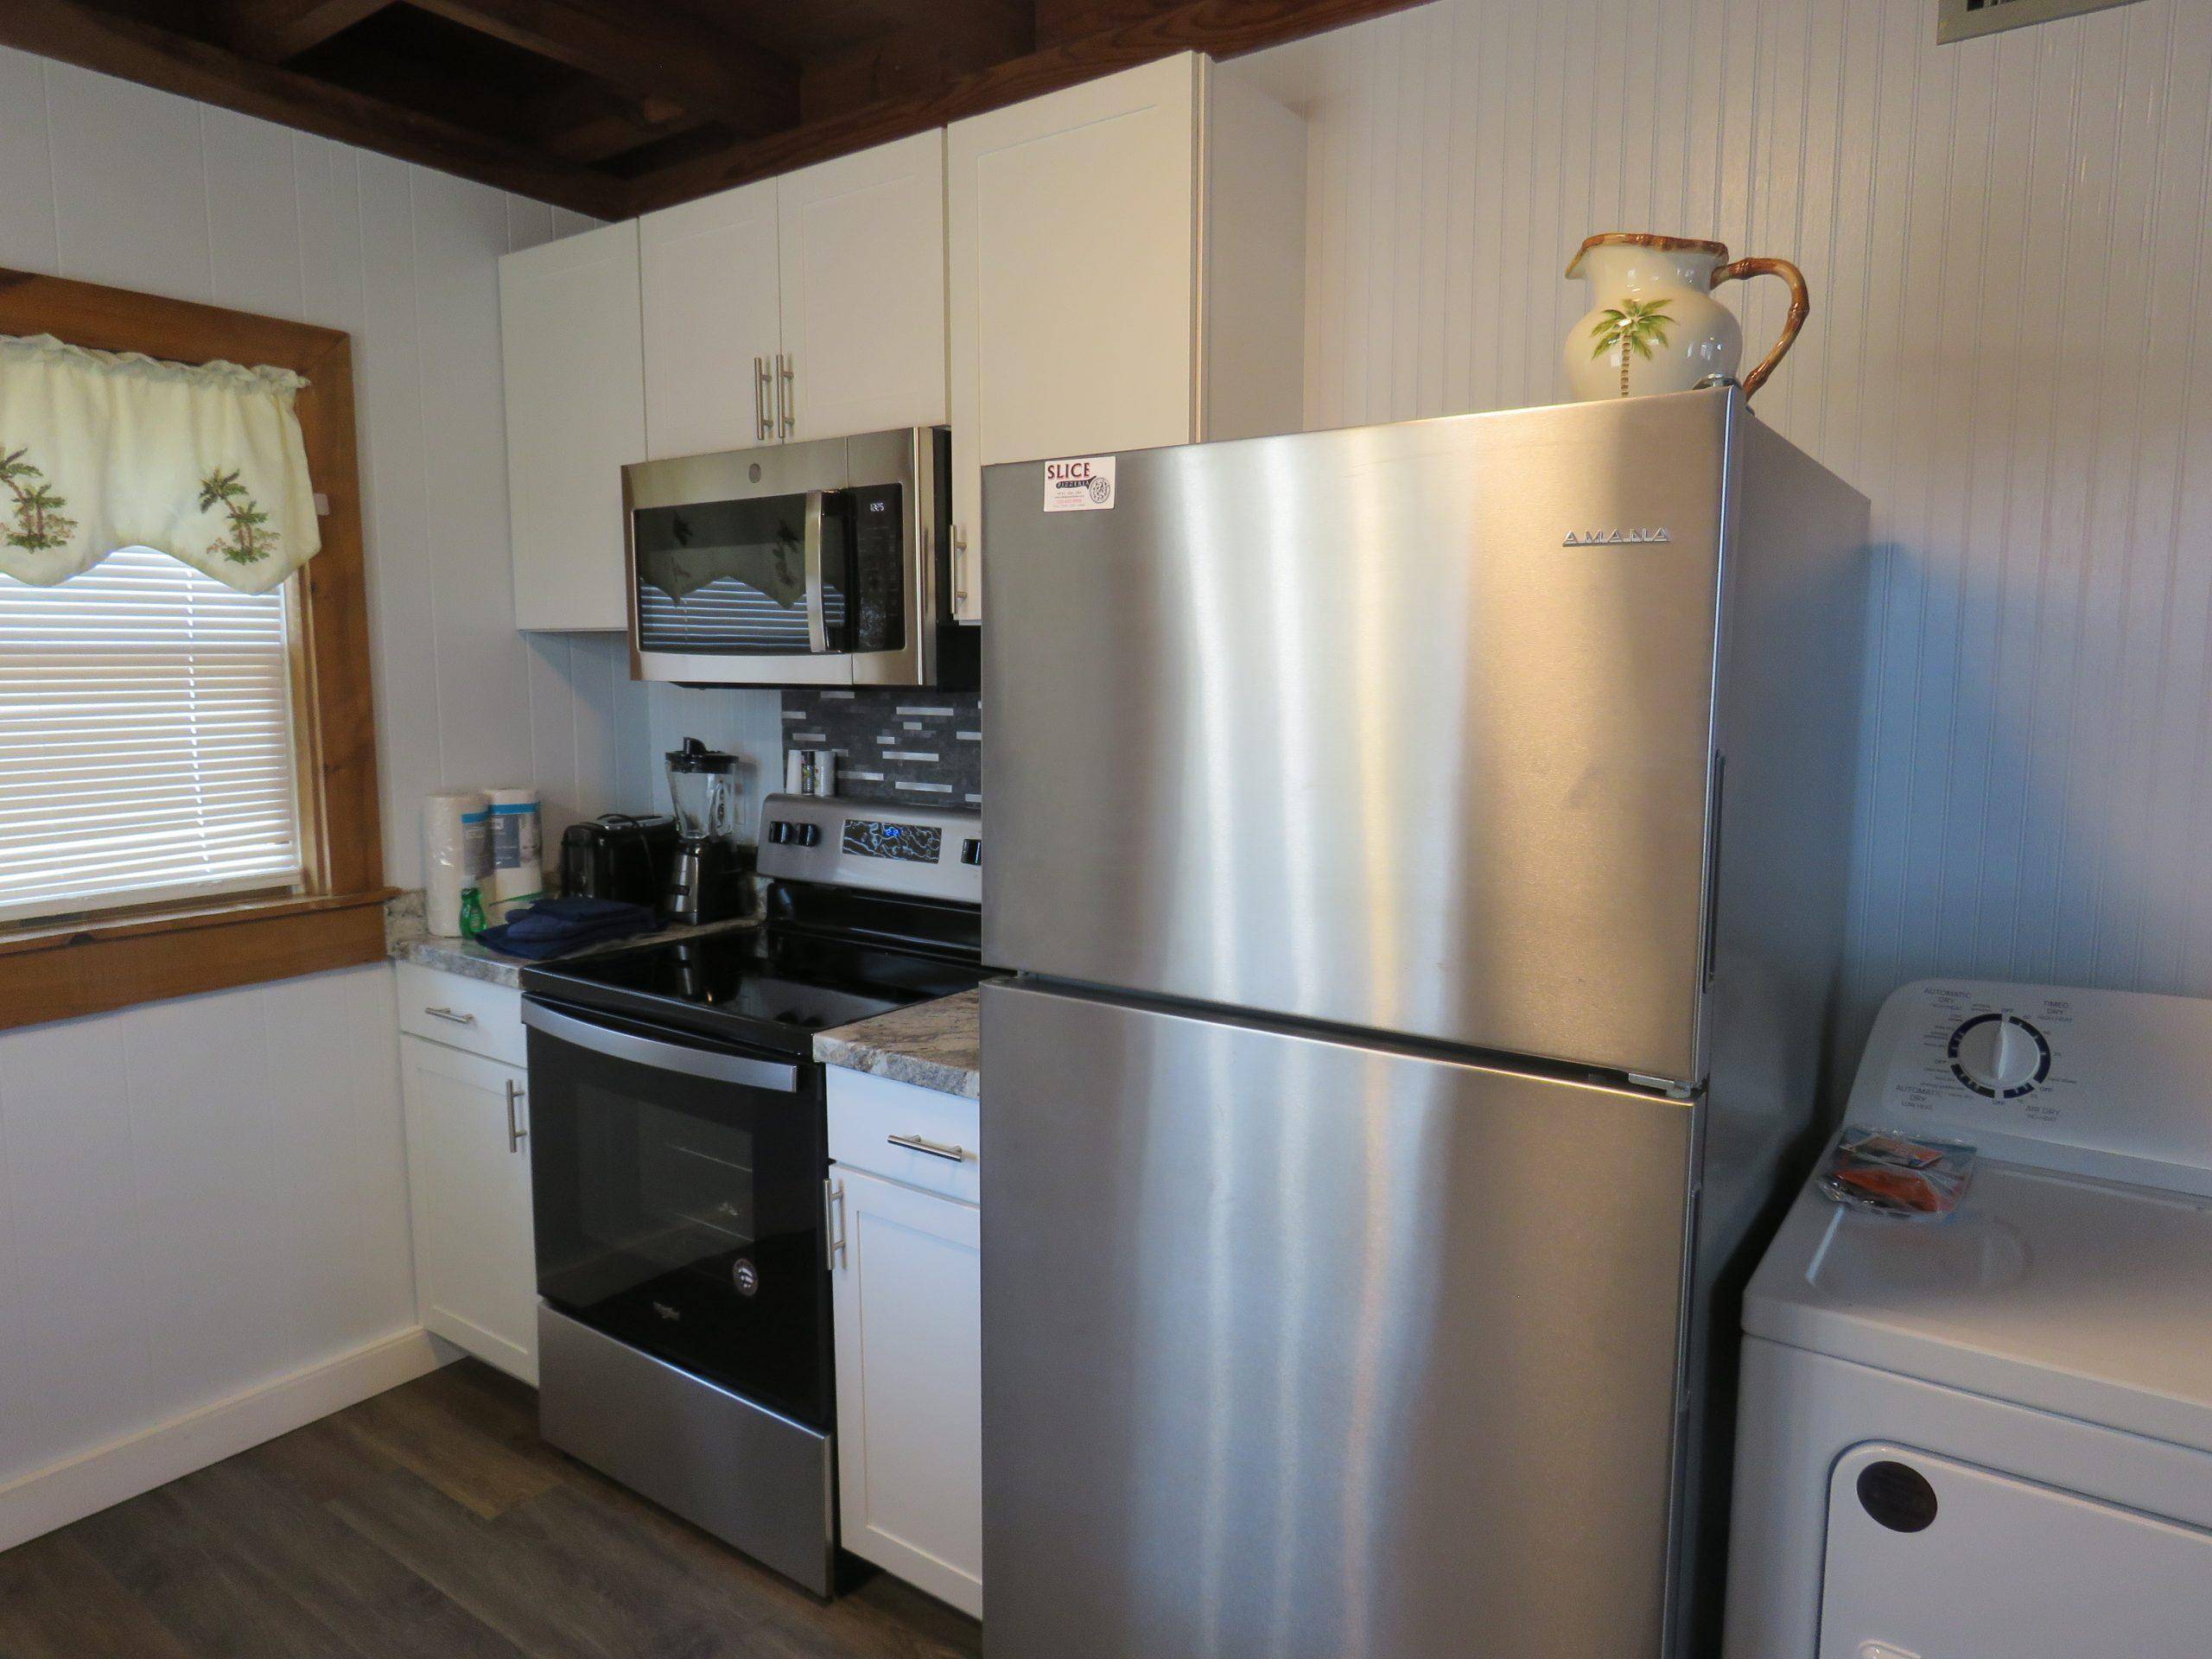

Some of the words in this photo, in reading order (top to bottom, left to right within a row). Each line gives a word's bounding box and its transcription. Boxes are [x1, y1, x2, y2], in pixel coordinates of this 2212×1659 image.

[1047, 462, 1090, 479] SLICE
[1562, 527, 1669, 545] AMANA
[1923, 988, 1971, 999] AUTOMATIC
